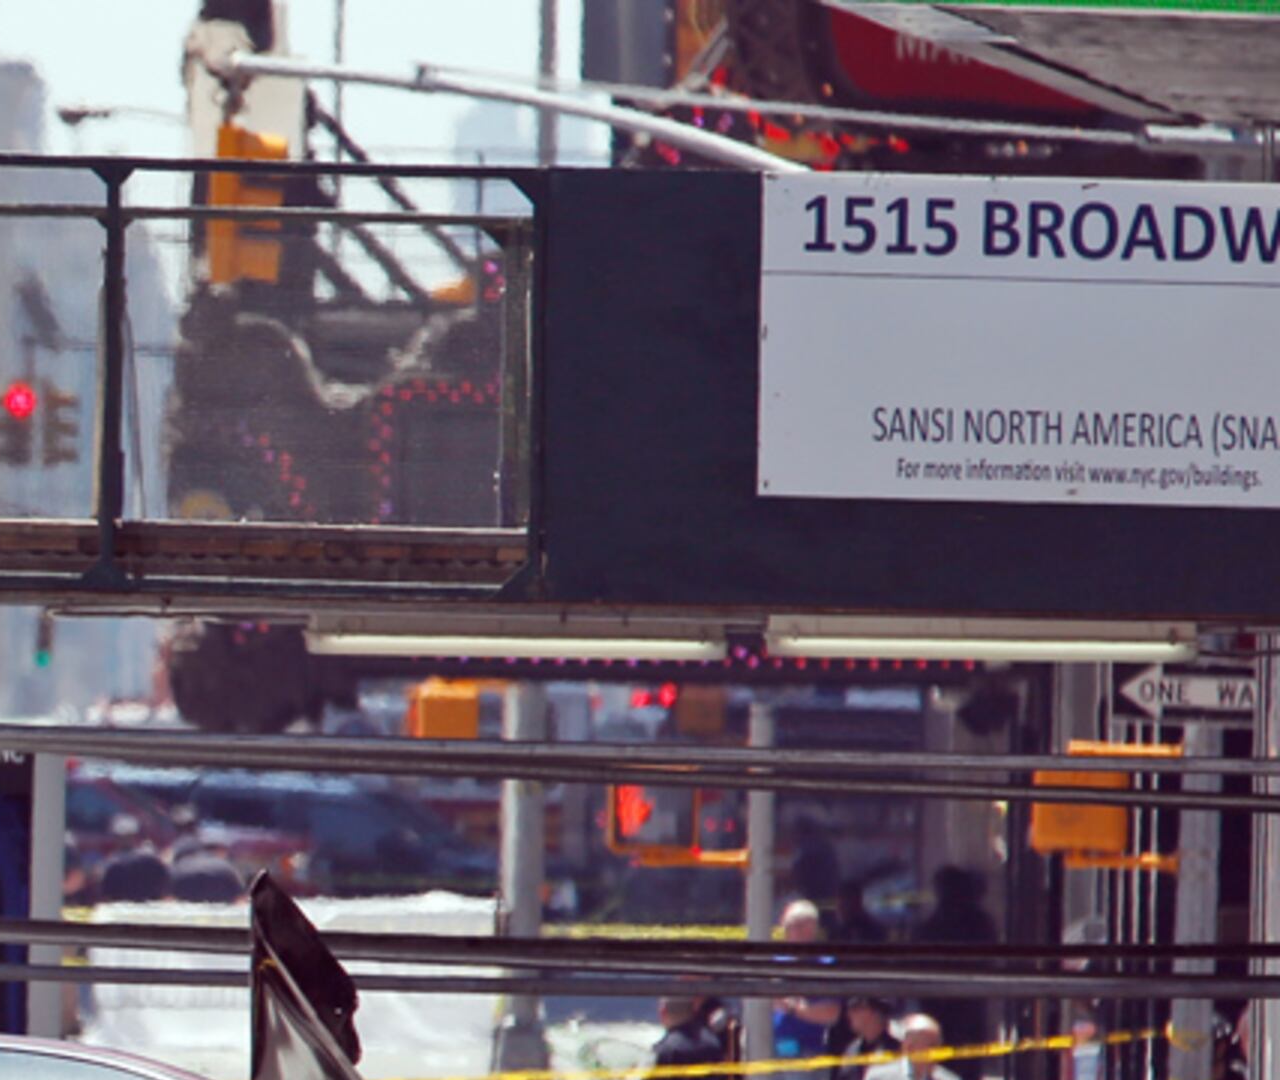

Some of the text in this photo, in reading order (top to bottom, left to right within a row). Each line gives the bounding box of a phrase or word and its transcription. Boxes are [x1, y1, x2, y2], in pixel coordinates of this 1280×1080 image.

[803, 195, 1280, 264] 1515 BROADW
[872, 406, 1280, 457] SANSI NORTH AMERICA (SNA
[896, 457, 920, 480] For
[923, 462, 962, 481] more
[965, 457, 1052, 482] information
[1055, 460, 1086, 484] visit
[1138, 680, 1182, 703] ONE
